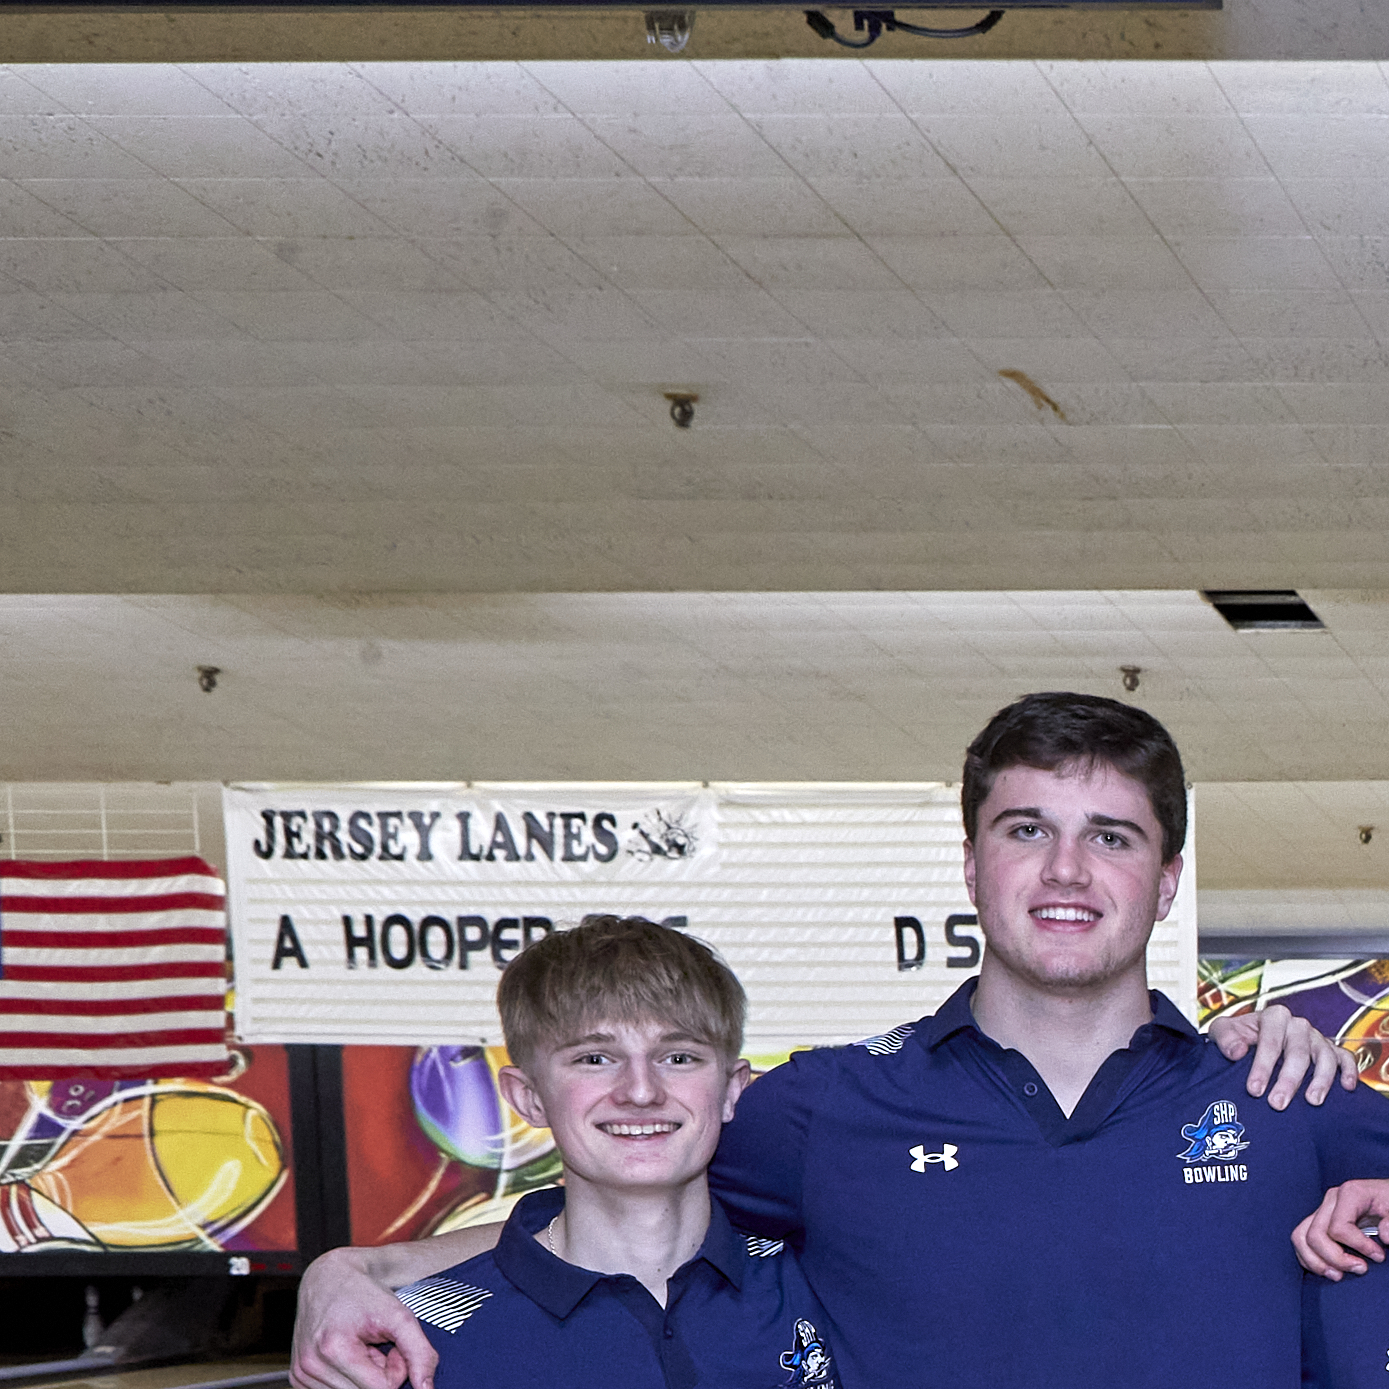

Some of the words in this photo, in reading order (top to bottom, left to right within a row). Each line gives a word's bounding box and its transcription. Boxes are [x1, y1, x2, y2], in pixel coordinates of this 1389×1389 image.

[253, 809, 441, 861] JERSEY
[456, 811, 619, 863] LANES
[272, 914, 309, 970] A
[893, 915, 925, 971] D
[1213, 1103, 1235, 1125] SHP
[1183, 1164, 1248, 1184] BOWLING
